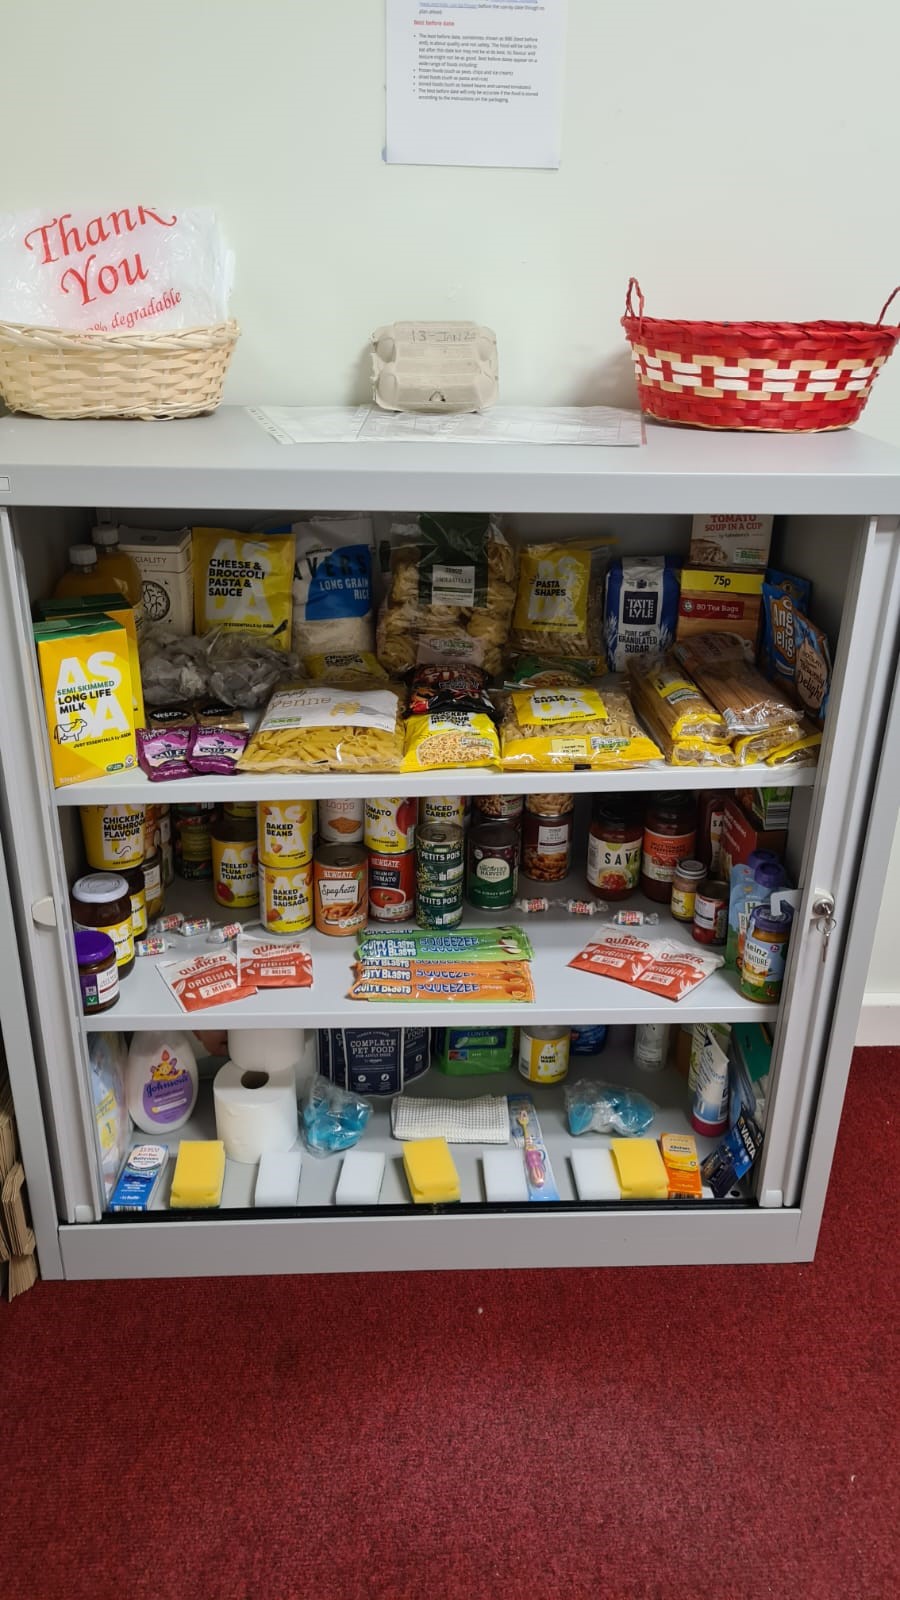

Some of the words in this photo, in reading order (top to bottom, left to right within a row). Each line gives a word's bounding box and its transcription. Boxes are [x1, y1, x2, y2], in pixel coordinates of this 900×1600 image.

[61, 253, 149, 306] You
[111, 287, 183, 328] degradable
[711, 514, 756, 523] TOMATO
[704, 523, 726, 532] SOUP
[726, 523, 735, 531] IN
[737, 522, 743, 531] A
[745, 522, 763, 530] CUP
[135, 556, 167, 564] CIALITY
[209, 558, 252, 569] CHEESE
[253, 561, 263, 570] &
[294, 553, 369, 582] AVERS
[208, 568, 266, 580] BROCCOLI
[208, 577, 243, 588] PASTA
[243, 579, 253, 588] &
[319, 579, 344, 592] LONG
[536, 580, 561, 588] PASTA
[713, 575, 731, 588] 75p
[208, 587, 243, 597] SAUCE
[534, 588, 567, 597] SHAPES
[627, 599, 654, 609] TATE
[721, 605, 740, 614] Bags
[628, 607, 654, 619] LYLE
[618, 636, 658, 645] GRANULATED
[624, 644, 649, 653] SUGAR
[56, 685, 77, 696] SEMI
[77, 680, 115, 691] SKIMMED
[58, 692, 88, 706] LONG
[88, 688, 112, 700] LIFE
[58, 702, 86, 715] MILK
[85, 737, 114, 747] ESSENTIALS
[426, 804, 453, 812] SLICED
[103, 814, 140, 824] CHICKEN
[425, 810, 460, 818] CARROTS
[103, 818, 146, 832] MUSHROO
[266, 822, 294, 830] BAKED
[103, 828, 141, 839] FLAVOUR
[266, 829, 293, 837] BEANS
[421, 851, 444, 862] PETITS
[445, 851, 461, 861] POIS
[604, 850, 639, 865] SAVE
[221, 867, 242, 875] PLUM
[321, 882, 356, 899] Spaghetti
[419, 895, 442, 906] PETITS
[442, 895, 457, 905] POIS
[419, 936, 480, 947] SQUEEZEE
[605, 937, 650, 949] QUAKER
[252, 943, 301, 956] QUAKER
[593, 949, 637, 961] ORIGINAL
[252, 959, 300, 969] ORIGINAL
[601, 957, 620, 967] MINS
[660, 952, 705, 965] QUAKER
[747, 954, 769, 967] NATURE
[178, 955, 228, 977] QUAKER
[270, 968, 292, 977] MINS
[187, 969, 237, 990] ORIGINAL
[650, 975, 669, 985] MINS
[211, 983, 232, 995] MINS
[416, 983, 480, 993] SQUEEZEE
[350, 1038, 397, 1048] COMPLETE
[352, 1046, 369, 1055] PET
[370, 1046, 395, 1054] FOOD
[740, 1124, 757, 1160] VARTA
